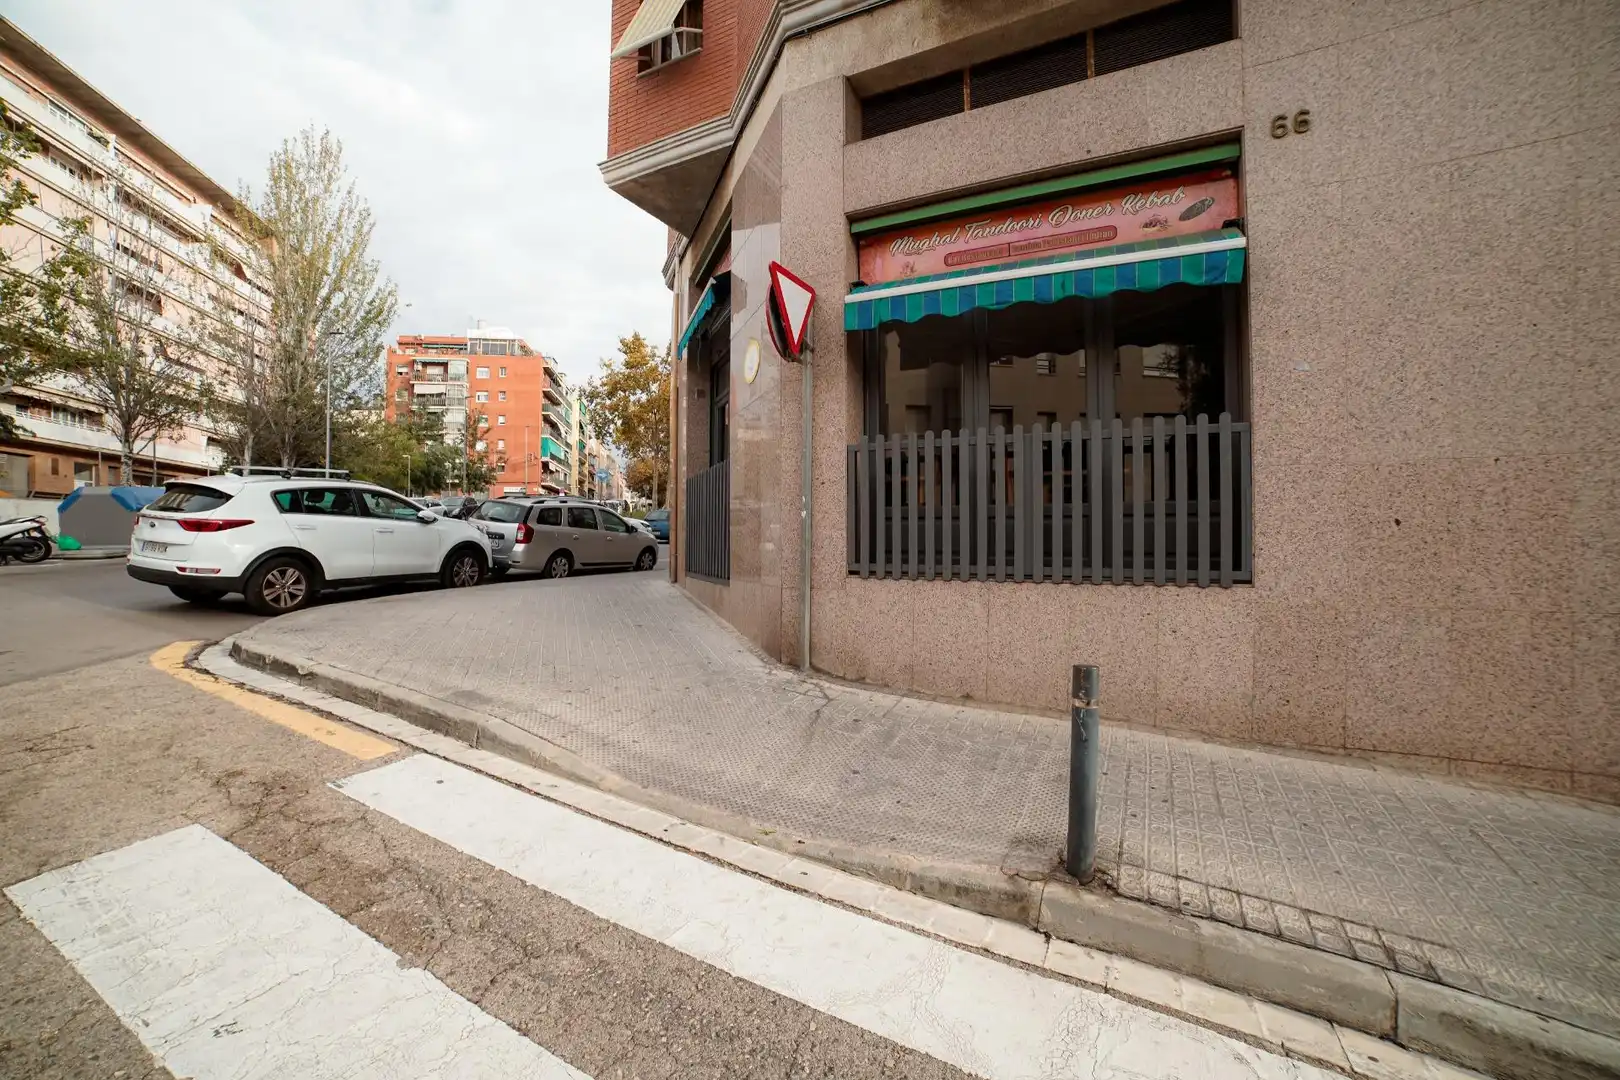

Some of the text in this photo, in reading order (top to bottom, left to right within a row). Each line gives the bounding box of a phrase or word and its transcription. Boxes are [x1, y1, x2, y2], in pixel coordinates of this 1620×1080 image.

[1271, 109, 1311, 140] 66
[889, 228, 960, 256] Mughal
[964, 213, 1041, 243] Tandoori
[1121, 185, 1186, 216] Kebab
